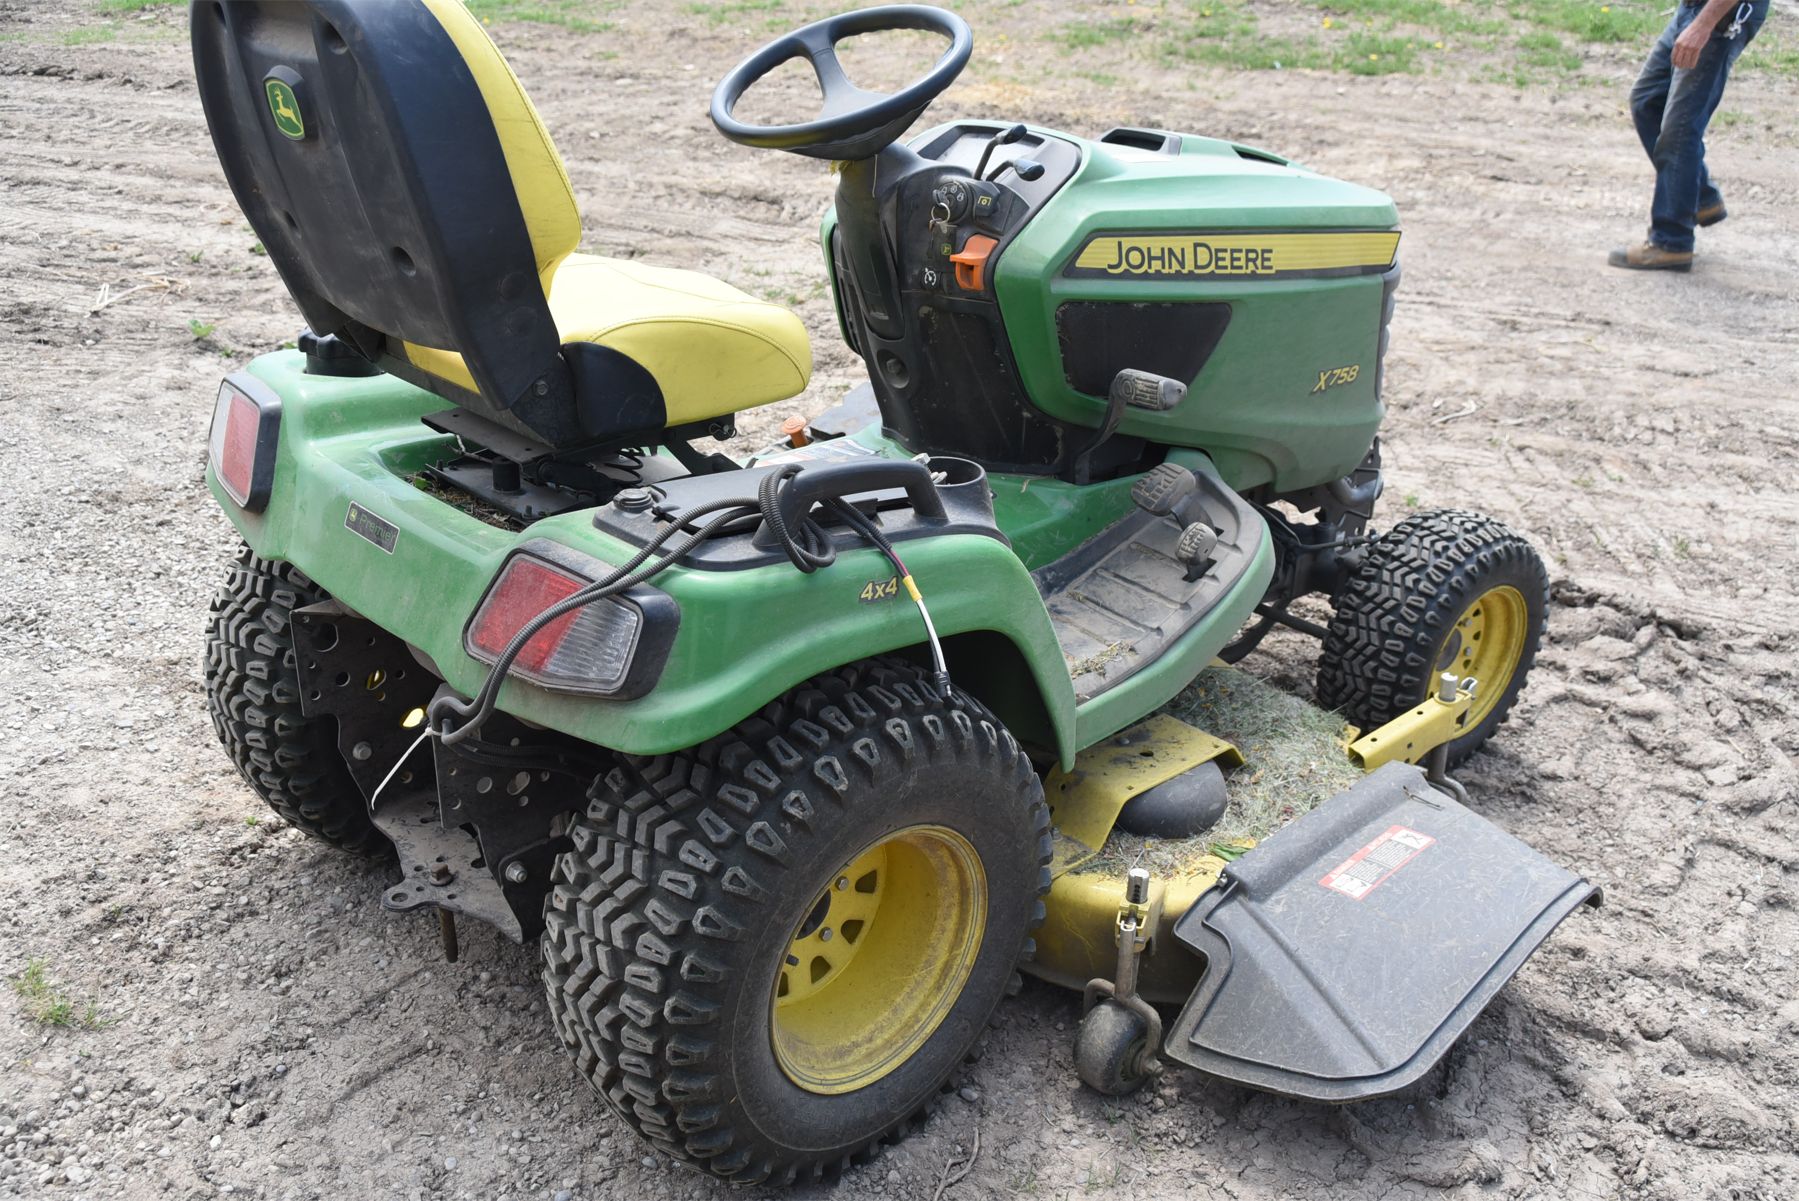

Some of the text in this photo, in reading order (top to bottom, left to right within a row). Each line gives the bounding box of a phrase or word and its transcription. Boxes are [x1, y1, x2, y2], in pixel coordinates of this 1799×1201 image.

[1107, 241, 1274, 271] JOHN DEERE
[1312, 365, 1360, 392] X758
